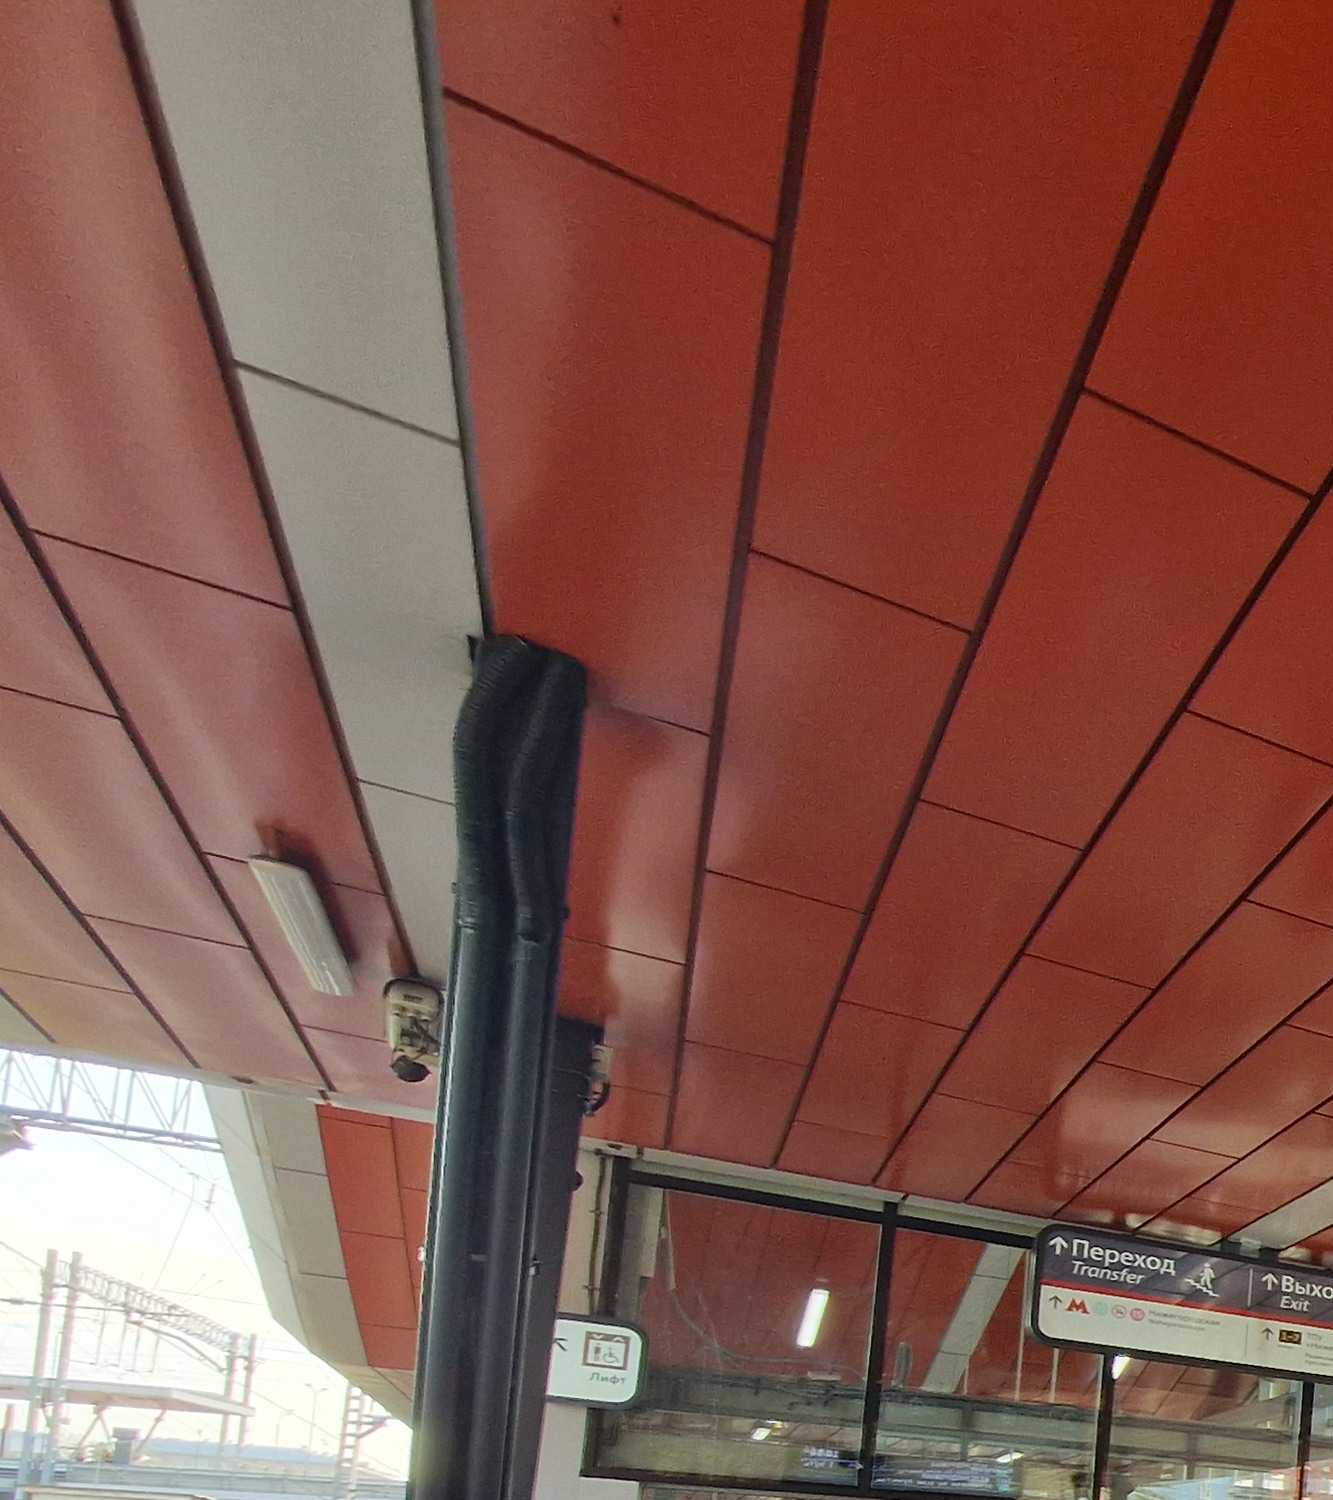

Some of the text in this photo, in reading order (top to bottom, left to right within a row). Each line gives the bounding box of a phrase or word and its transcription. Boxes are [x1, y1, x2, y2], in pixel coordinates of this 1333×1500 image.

[1071, 1238, 1176, 1276] Переход
[1071, 1260, 1145, 1285] Transfer
[1280, 1295, 1311, 1312] Exit
[590, 1371, 626, 1385] Лифт
